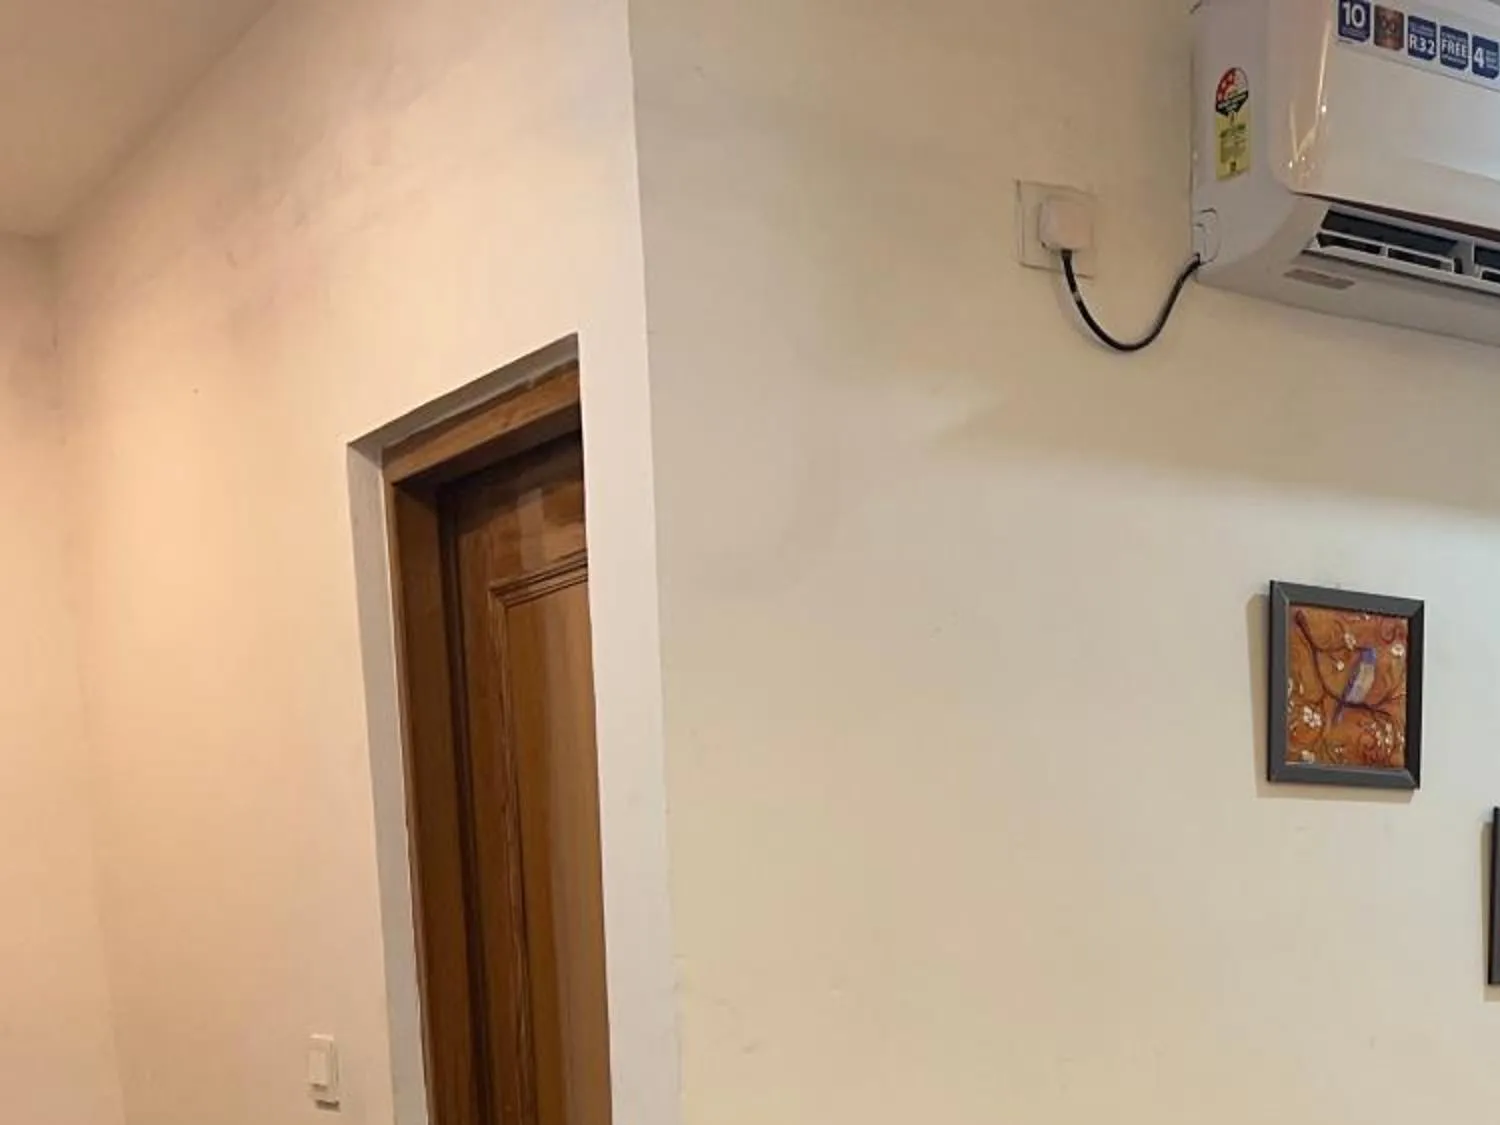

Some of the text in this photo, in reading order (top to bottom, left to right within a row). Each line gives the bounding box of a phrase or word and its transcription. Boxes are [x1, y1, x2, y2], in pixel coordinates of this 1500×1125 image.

[1342, 1, 1366, 28] 10
[1409, 33, 1435, 55] R32
[1441, 38, 1468, 58] FREE
[1473, 47, 1485, 68] 4
